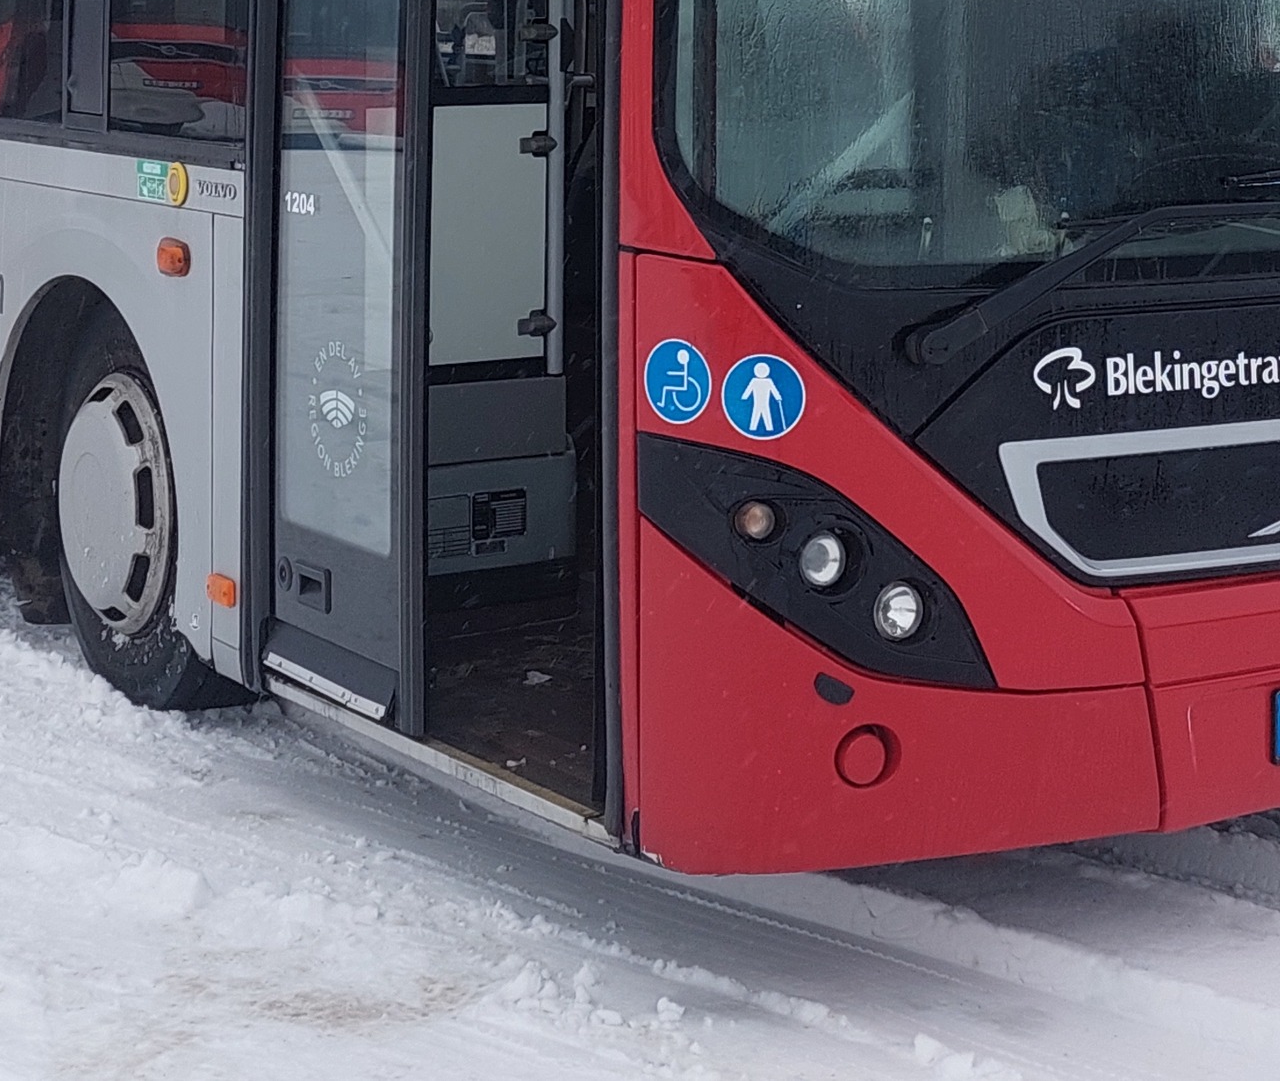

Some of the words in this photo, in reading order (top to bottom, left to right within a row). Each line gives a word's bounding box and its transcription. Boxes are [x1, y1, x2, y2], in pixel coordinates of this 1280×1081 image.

[196, 179, 238, 200] VOLVO
[285, 191, 315, 216] 1204
[314, 347, 328, 373] EN
[328, 340, 347, 360] DEL
[348, 356, 362, 379] AV
[307, 394, 332, 471] REGION
[333, 406, 368, 478] BLEKINGE
